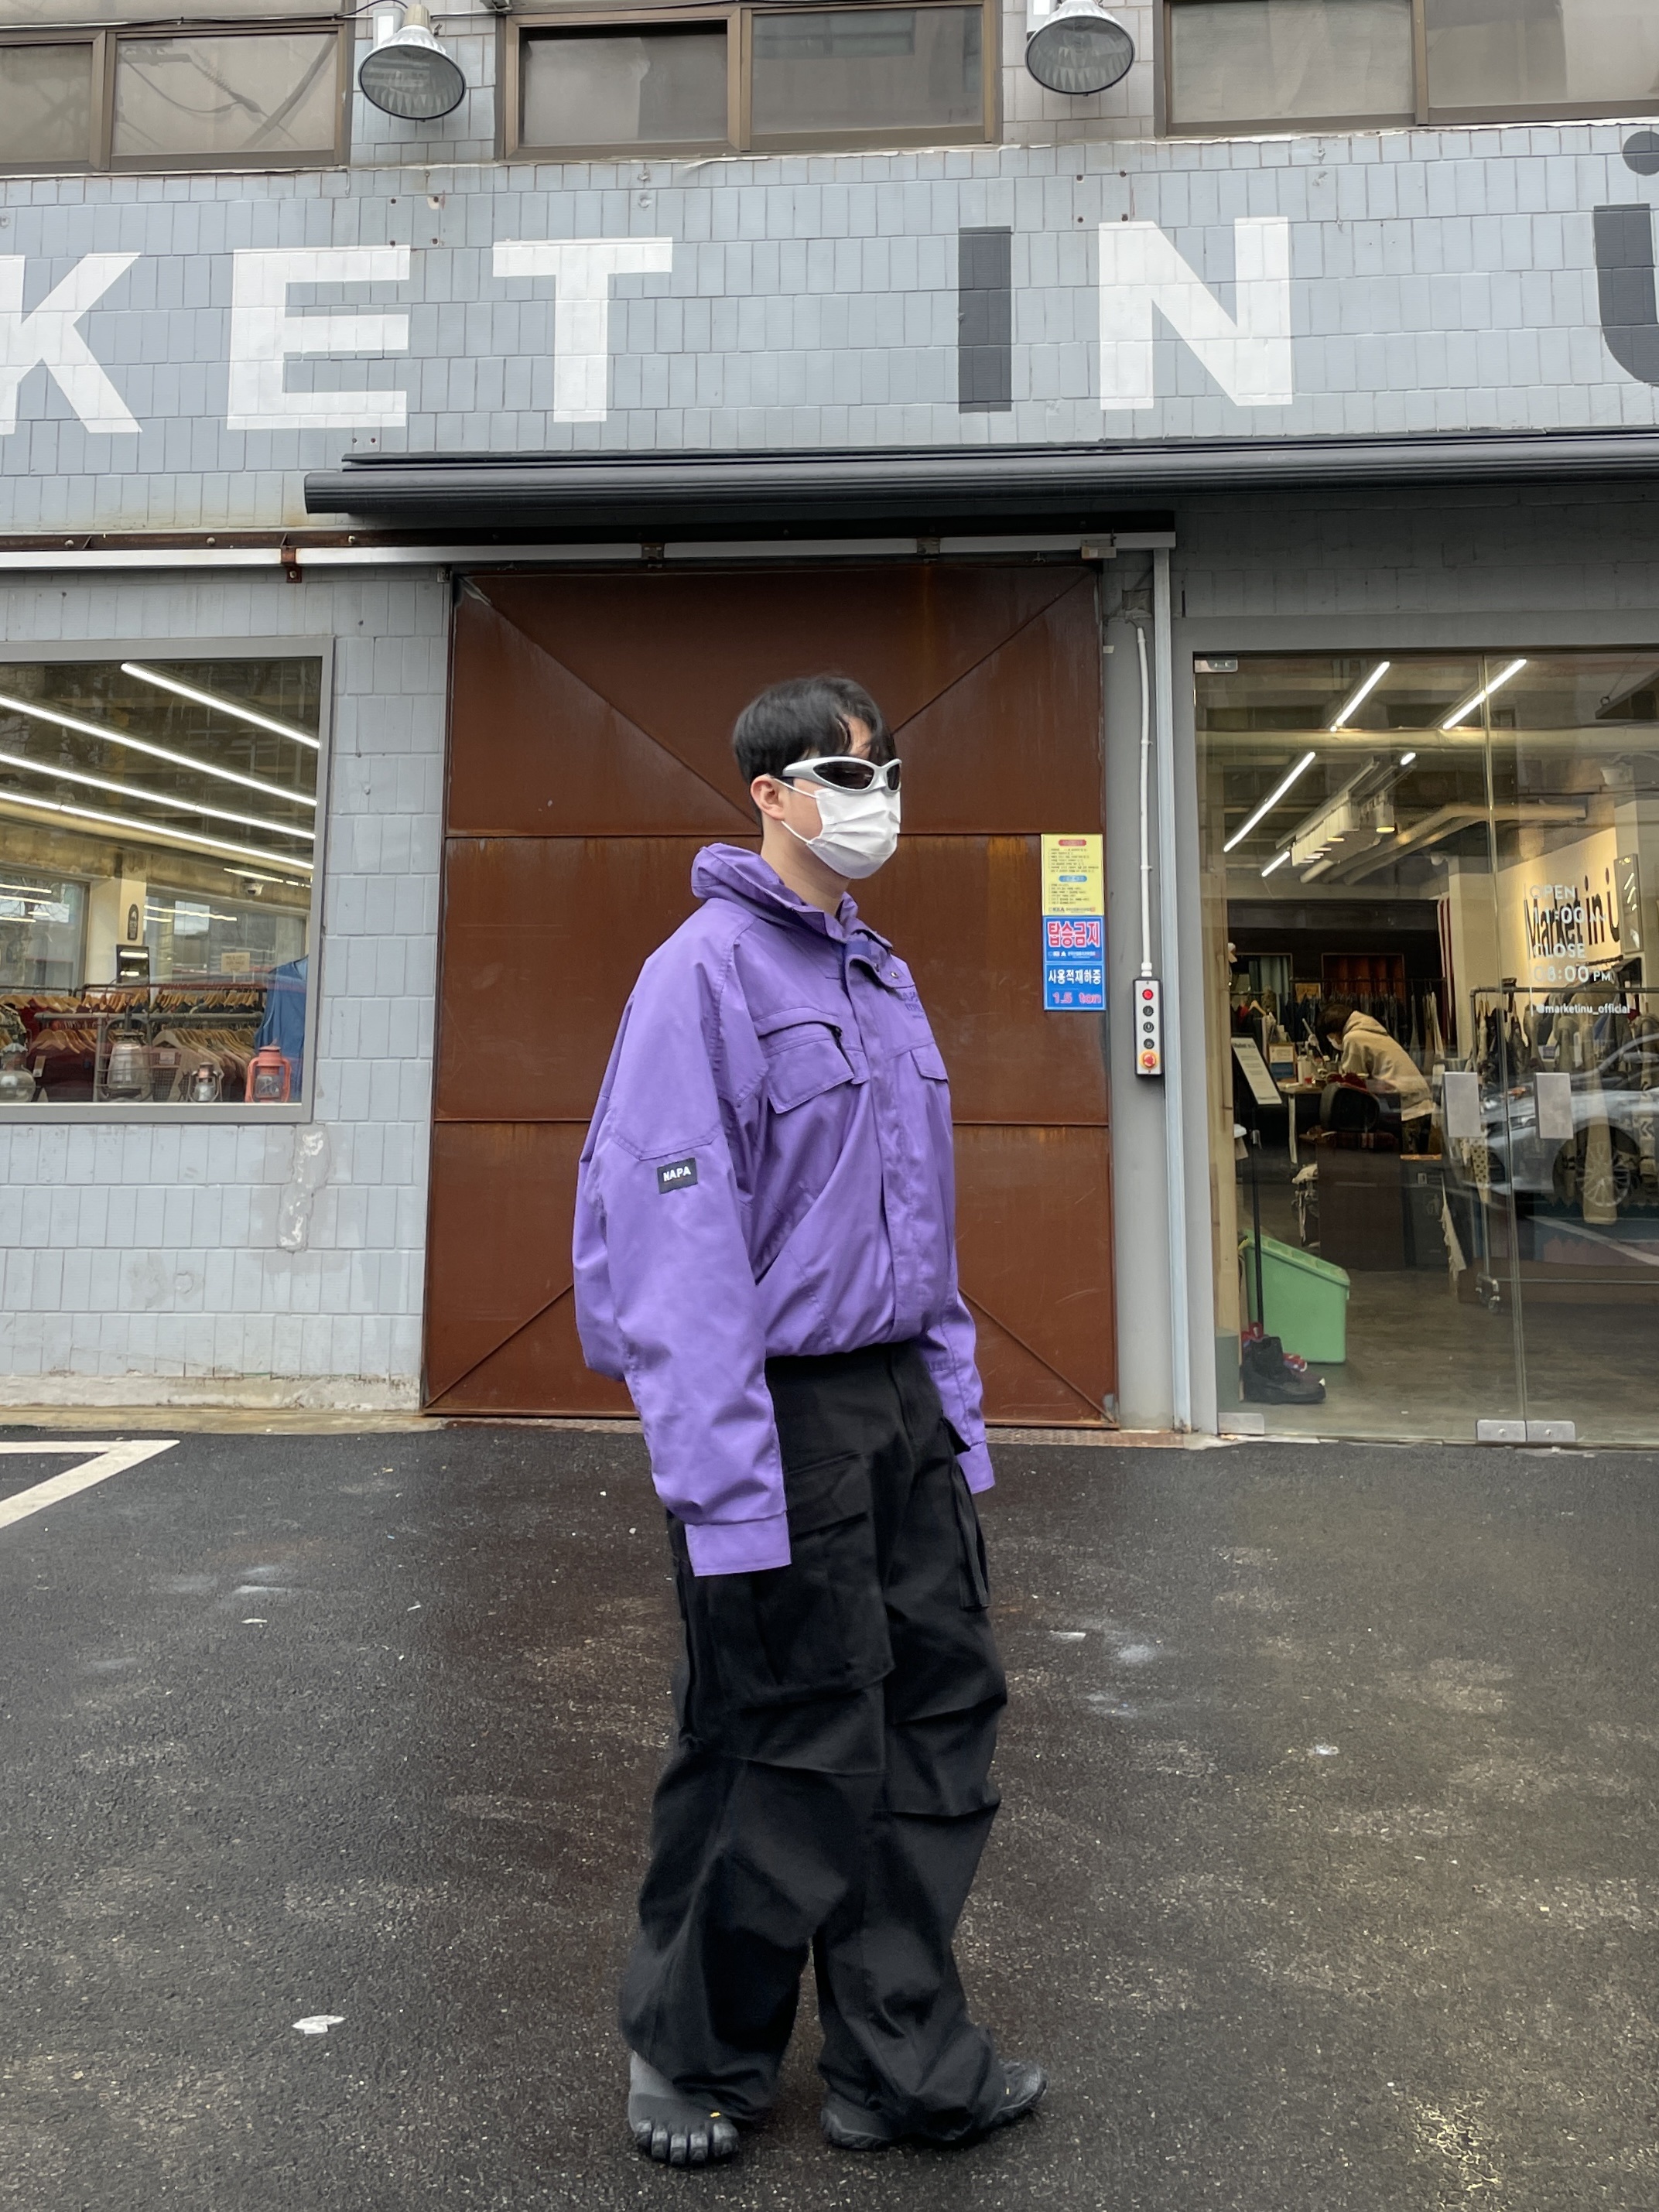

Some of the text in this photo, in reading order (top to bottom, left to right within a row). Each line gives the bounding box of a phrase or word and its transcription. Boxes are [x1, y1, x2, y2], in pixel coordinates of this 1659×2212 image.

[1531, 884, 1575, 900] OPEN
[1534, 906, 1585, 924] 11:00
[1048, 921, 1100, 948] 탑승금지
[1533, 942, 1586, 959] CLOSE
[1048, 969, 1101, 985] 사용적재하중
[1534, 965, 1612, 983] 08:00 PM
[1536, 1003, 1630, 1015] @marketinu_official
[662, 1166, 692, 1182] NAPA
